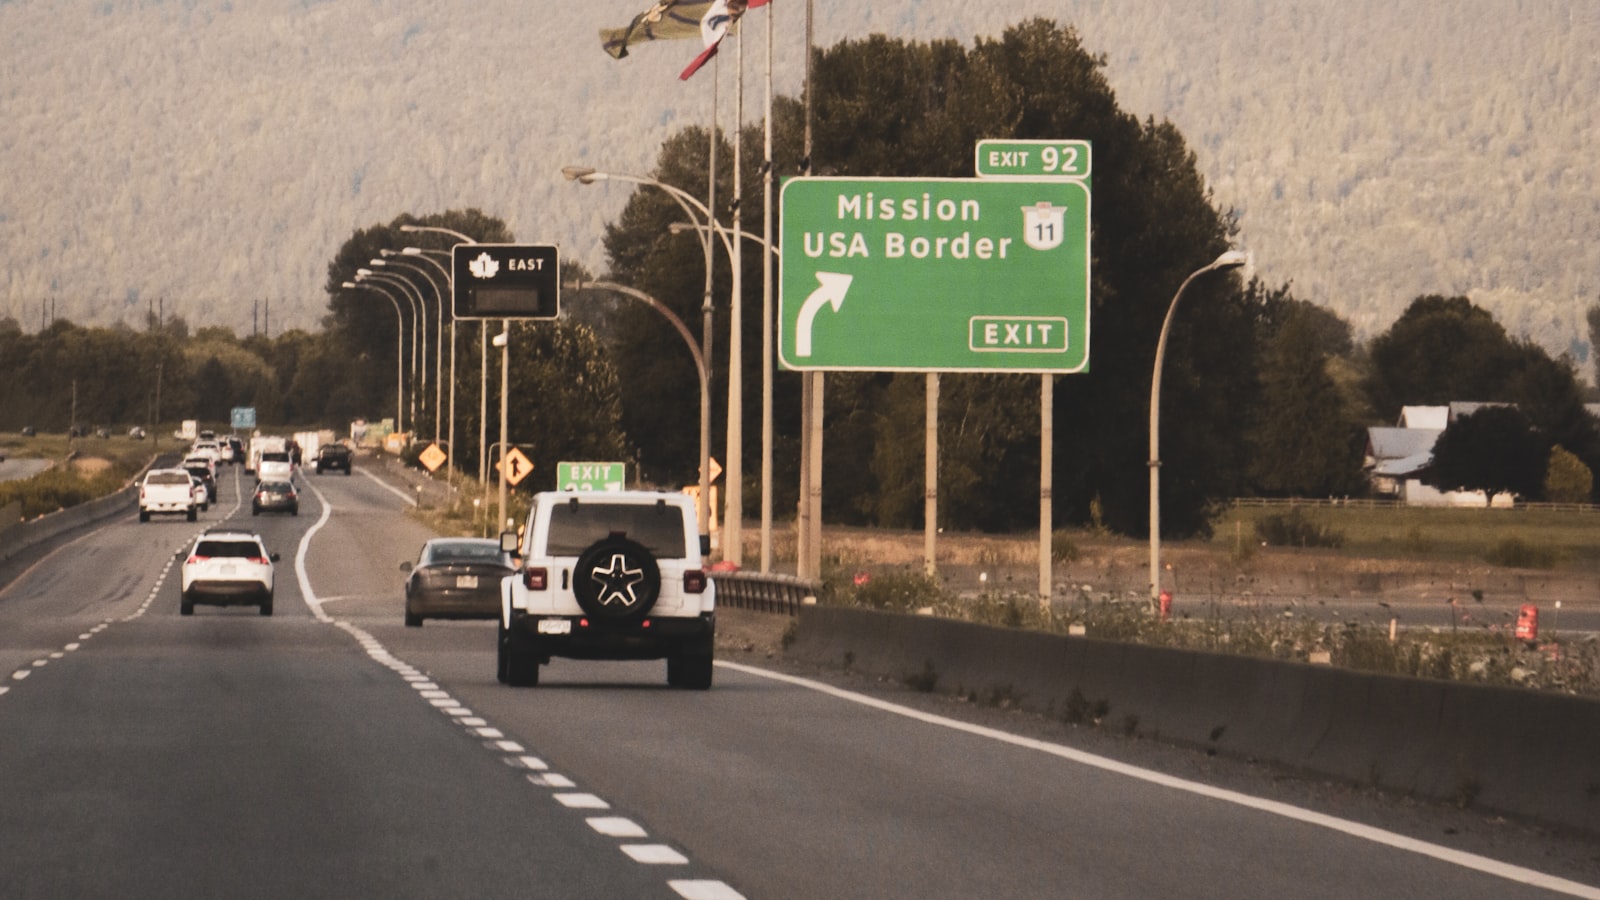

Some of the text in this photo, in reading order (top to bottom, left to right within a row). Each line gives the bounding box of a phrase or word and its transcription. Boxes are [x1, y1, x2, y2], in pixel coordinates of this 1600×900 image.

[989, 146, 1078, 172] EXIT 92
[838, 191, 980, 221] Mission
[1034, 223, 1054, 241] 11
[803, 231, 1012, 259] USA Border
[508, 258, 544, 271] EAST
[984, 323, 1052, 345] EXIT
[571, 465, 611, 481] EXIT
